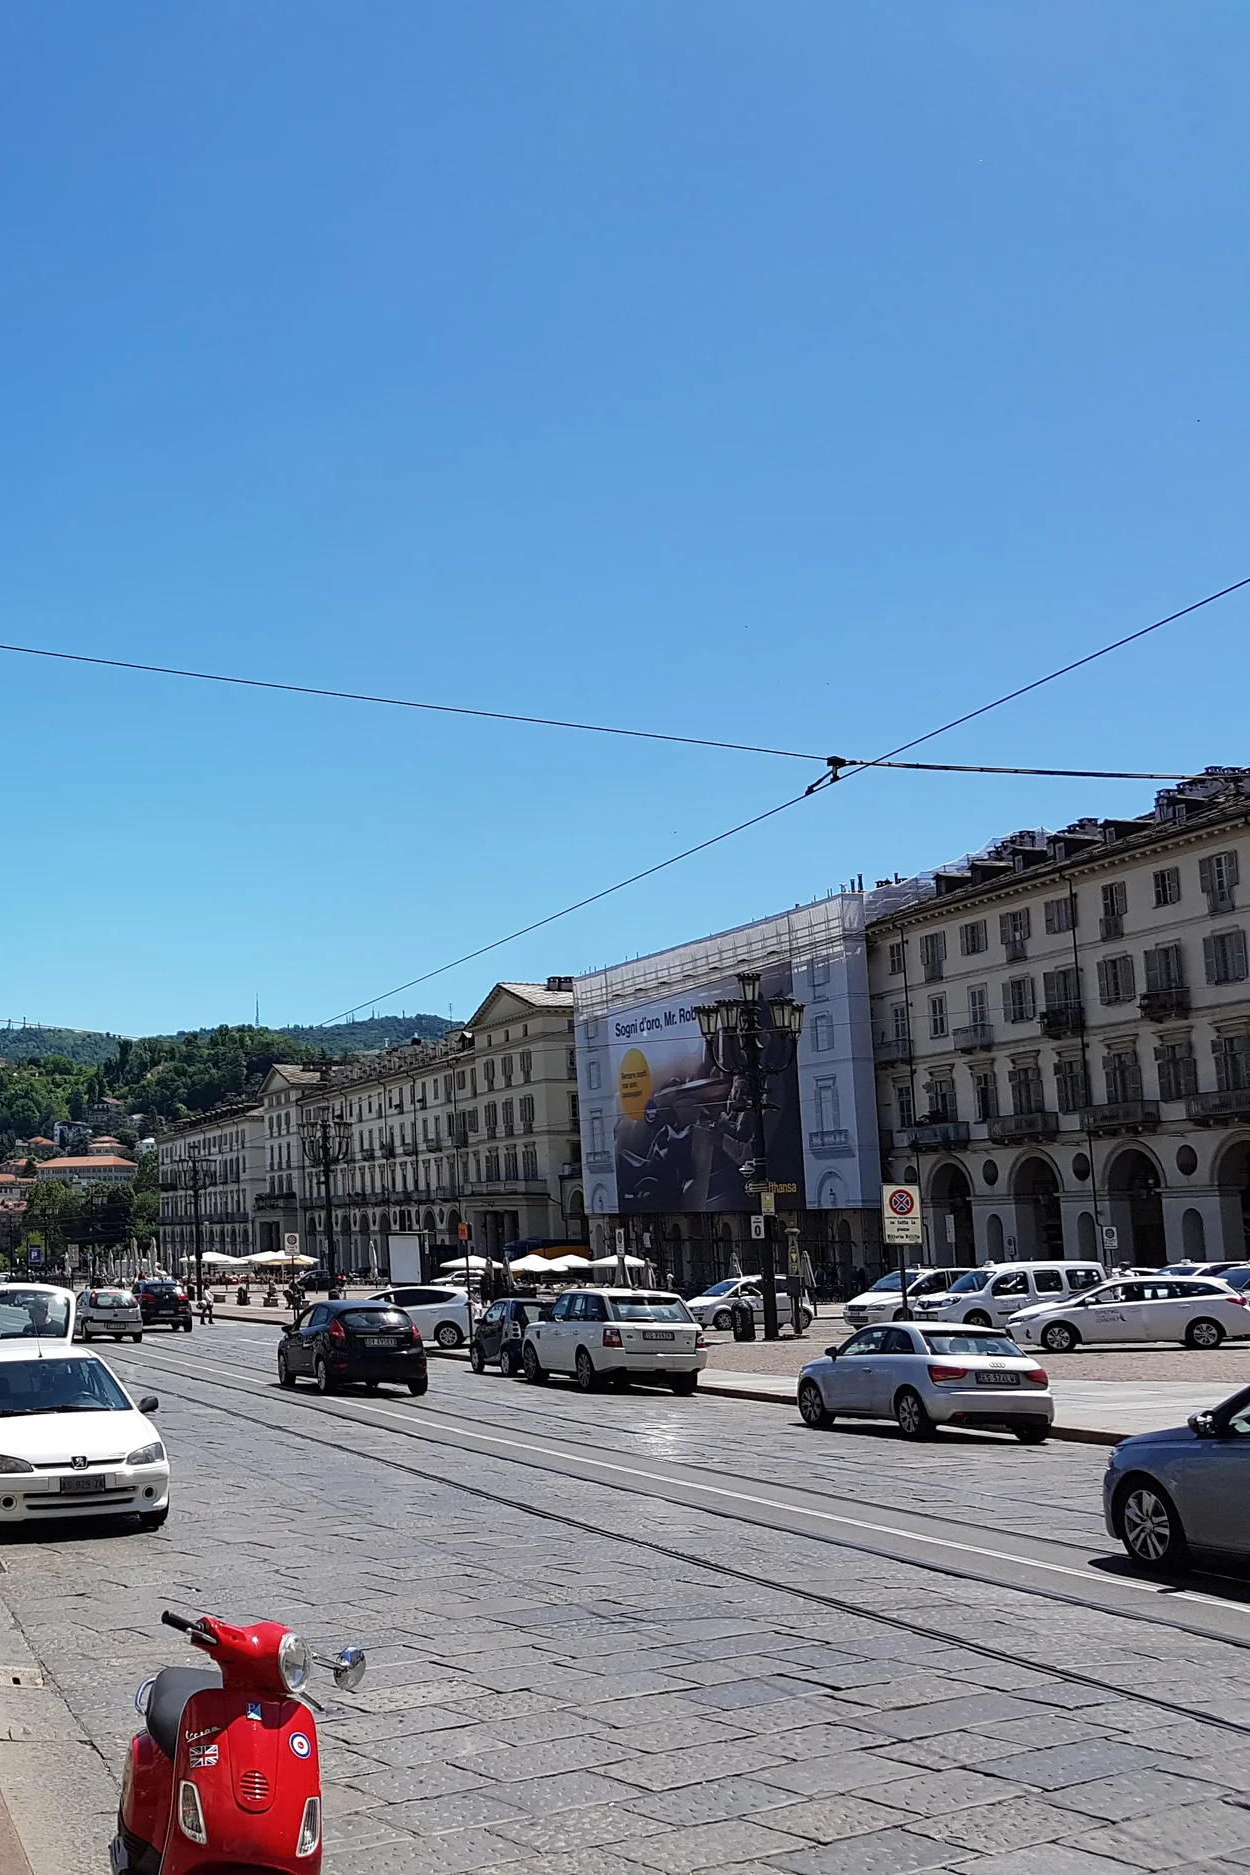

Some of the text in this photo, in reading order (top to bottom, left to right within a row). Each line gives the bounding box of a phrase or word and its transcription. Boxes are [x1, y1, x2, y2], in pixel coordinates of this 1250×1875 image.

[615, 1006, 697, 1038] Sogni d'oro, Mr. Rob
[768, 1181, 797, 1193] fthansa
[31, 1251, 38, 1260] P
[185, 1726, 221, 1743] Vespa
